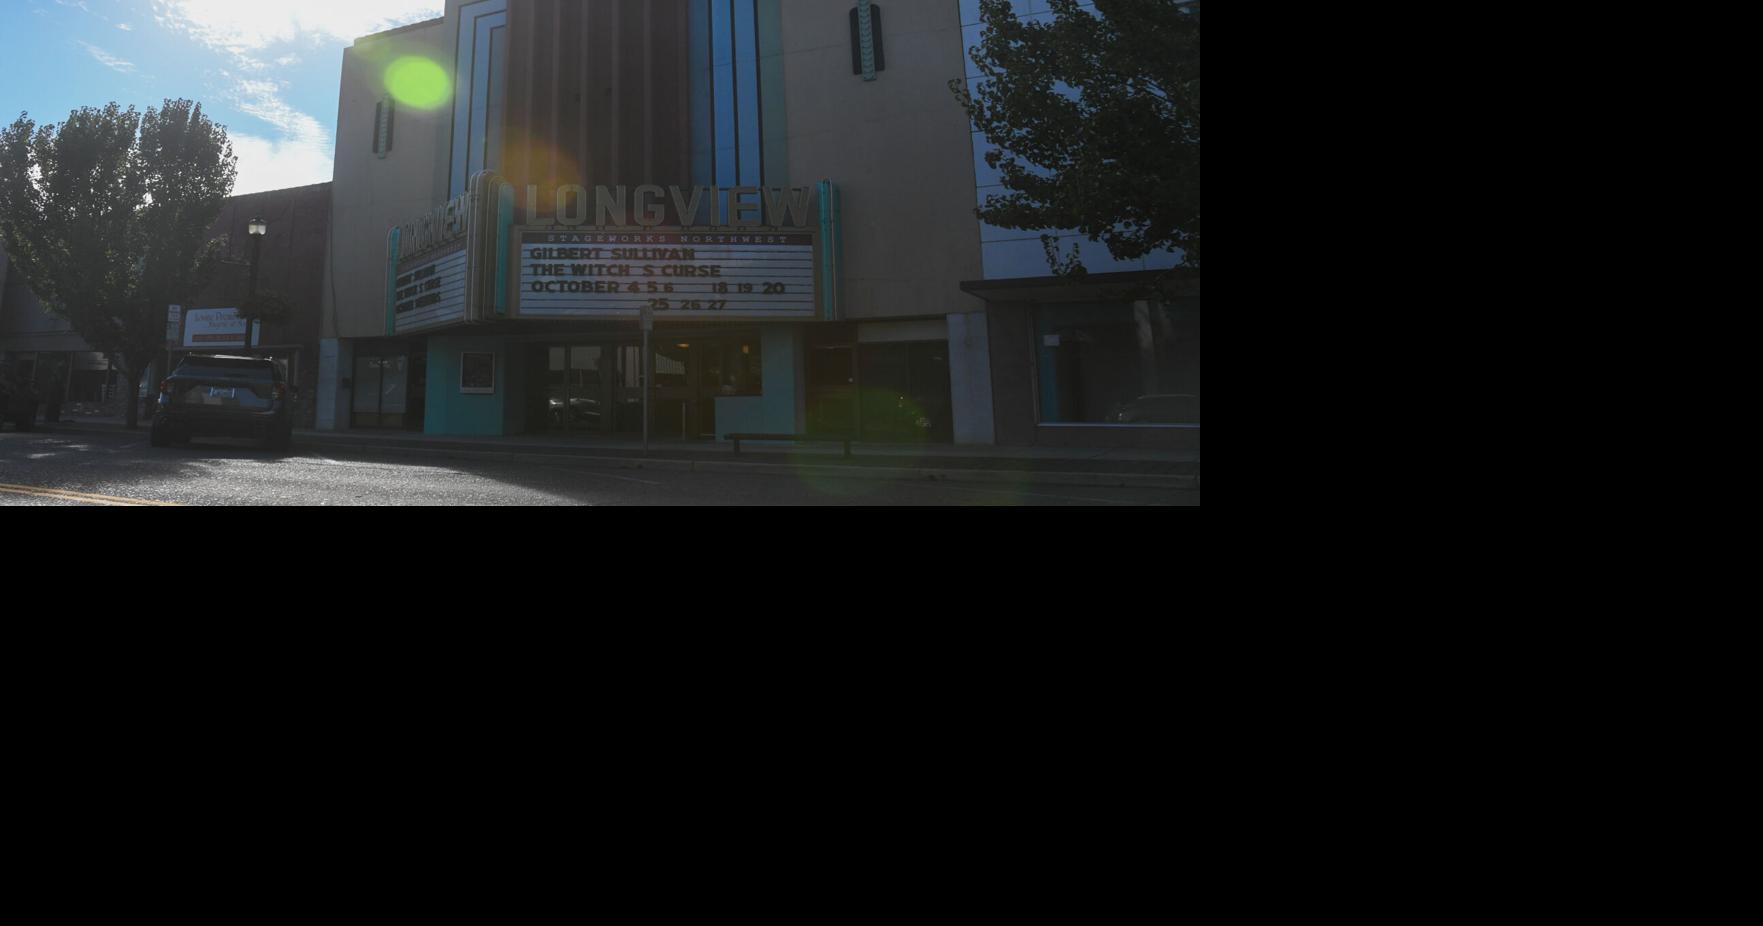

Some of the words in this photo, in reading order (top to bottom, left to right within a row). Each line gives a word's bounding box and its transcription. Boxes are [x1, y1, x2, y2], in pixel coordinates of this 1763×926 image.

[526, 184, 812, 227] LONGVIEW
[680, 235, 787, 243] NORTHWEST
[530, 247, 602, 259] GILBERT
[611, 248, 695, 260] SULLIVAN
[530, 263, 565, 276] THE
[570, 263, 630, 276] WITCH
[643, 264, 654, 277] S
[661, 265, 721, 277] CURSE
[531, 280, 619, 293] OCTOBER
[647, 281, 658, 293] 5
[664, 282, 674, 293] 6
[712, 282, 728, 294] 18
[737, 282, 753, 293] 19
[762, 281, 785, 294] 20
[647, 298, 669, 311] 25
[680, 299, 701, 310] 26
[708, 299, 727, 310] 27
